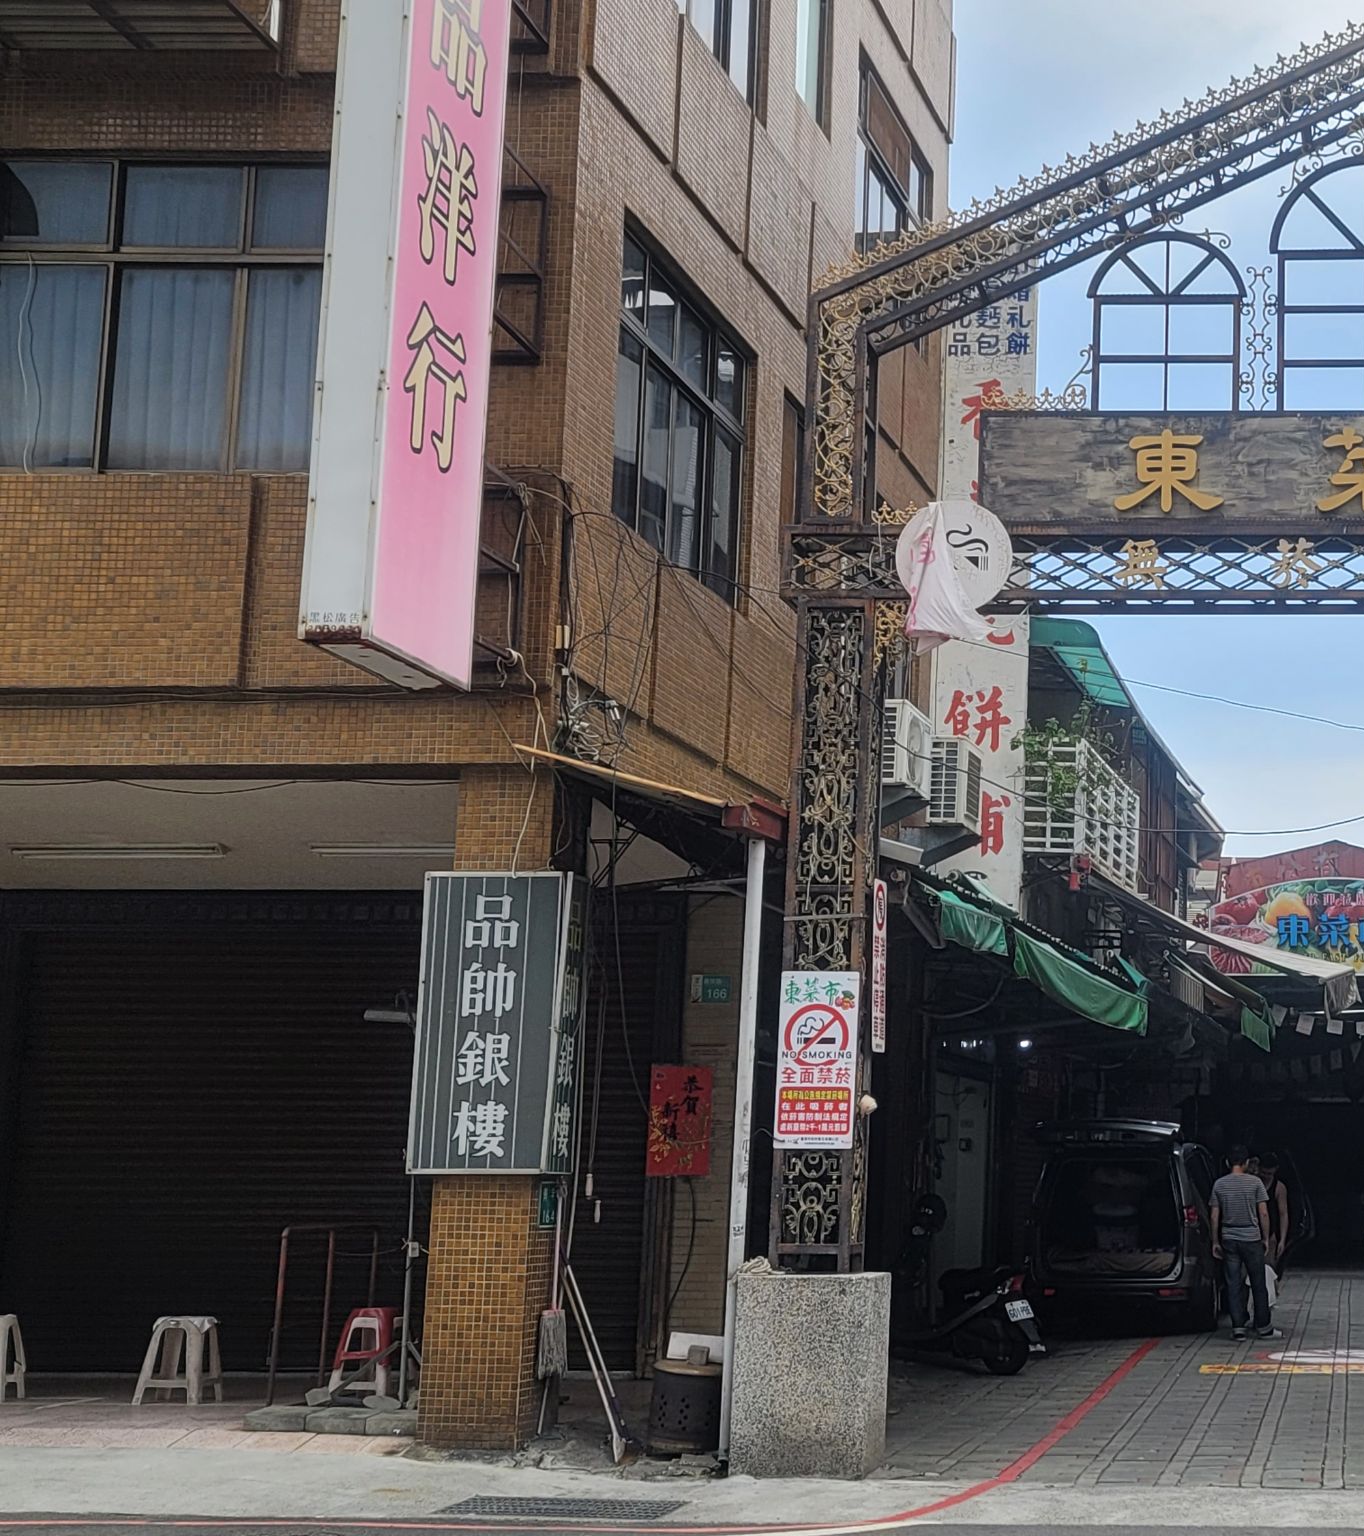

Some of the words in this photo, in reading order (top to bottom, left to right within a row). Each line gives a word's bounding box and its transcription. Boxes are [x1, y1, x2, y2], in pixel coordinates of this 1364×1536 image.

[707, 988, 728, 999] 166
[784, 977, 842, 1005] 東菜市
[451, 893, 520, 1160] 品帥銀樓
[782, 1051, 797, 1060] NO
[802, 1051, 852, 1060] SMOKING
[781, 1067, 851, 1085] 全面禁菸
[680, 1075, 704, 1116] 恭賀
